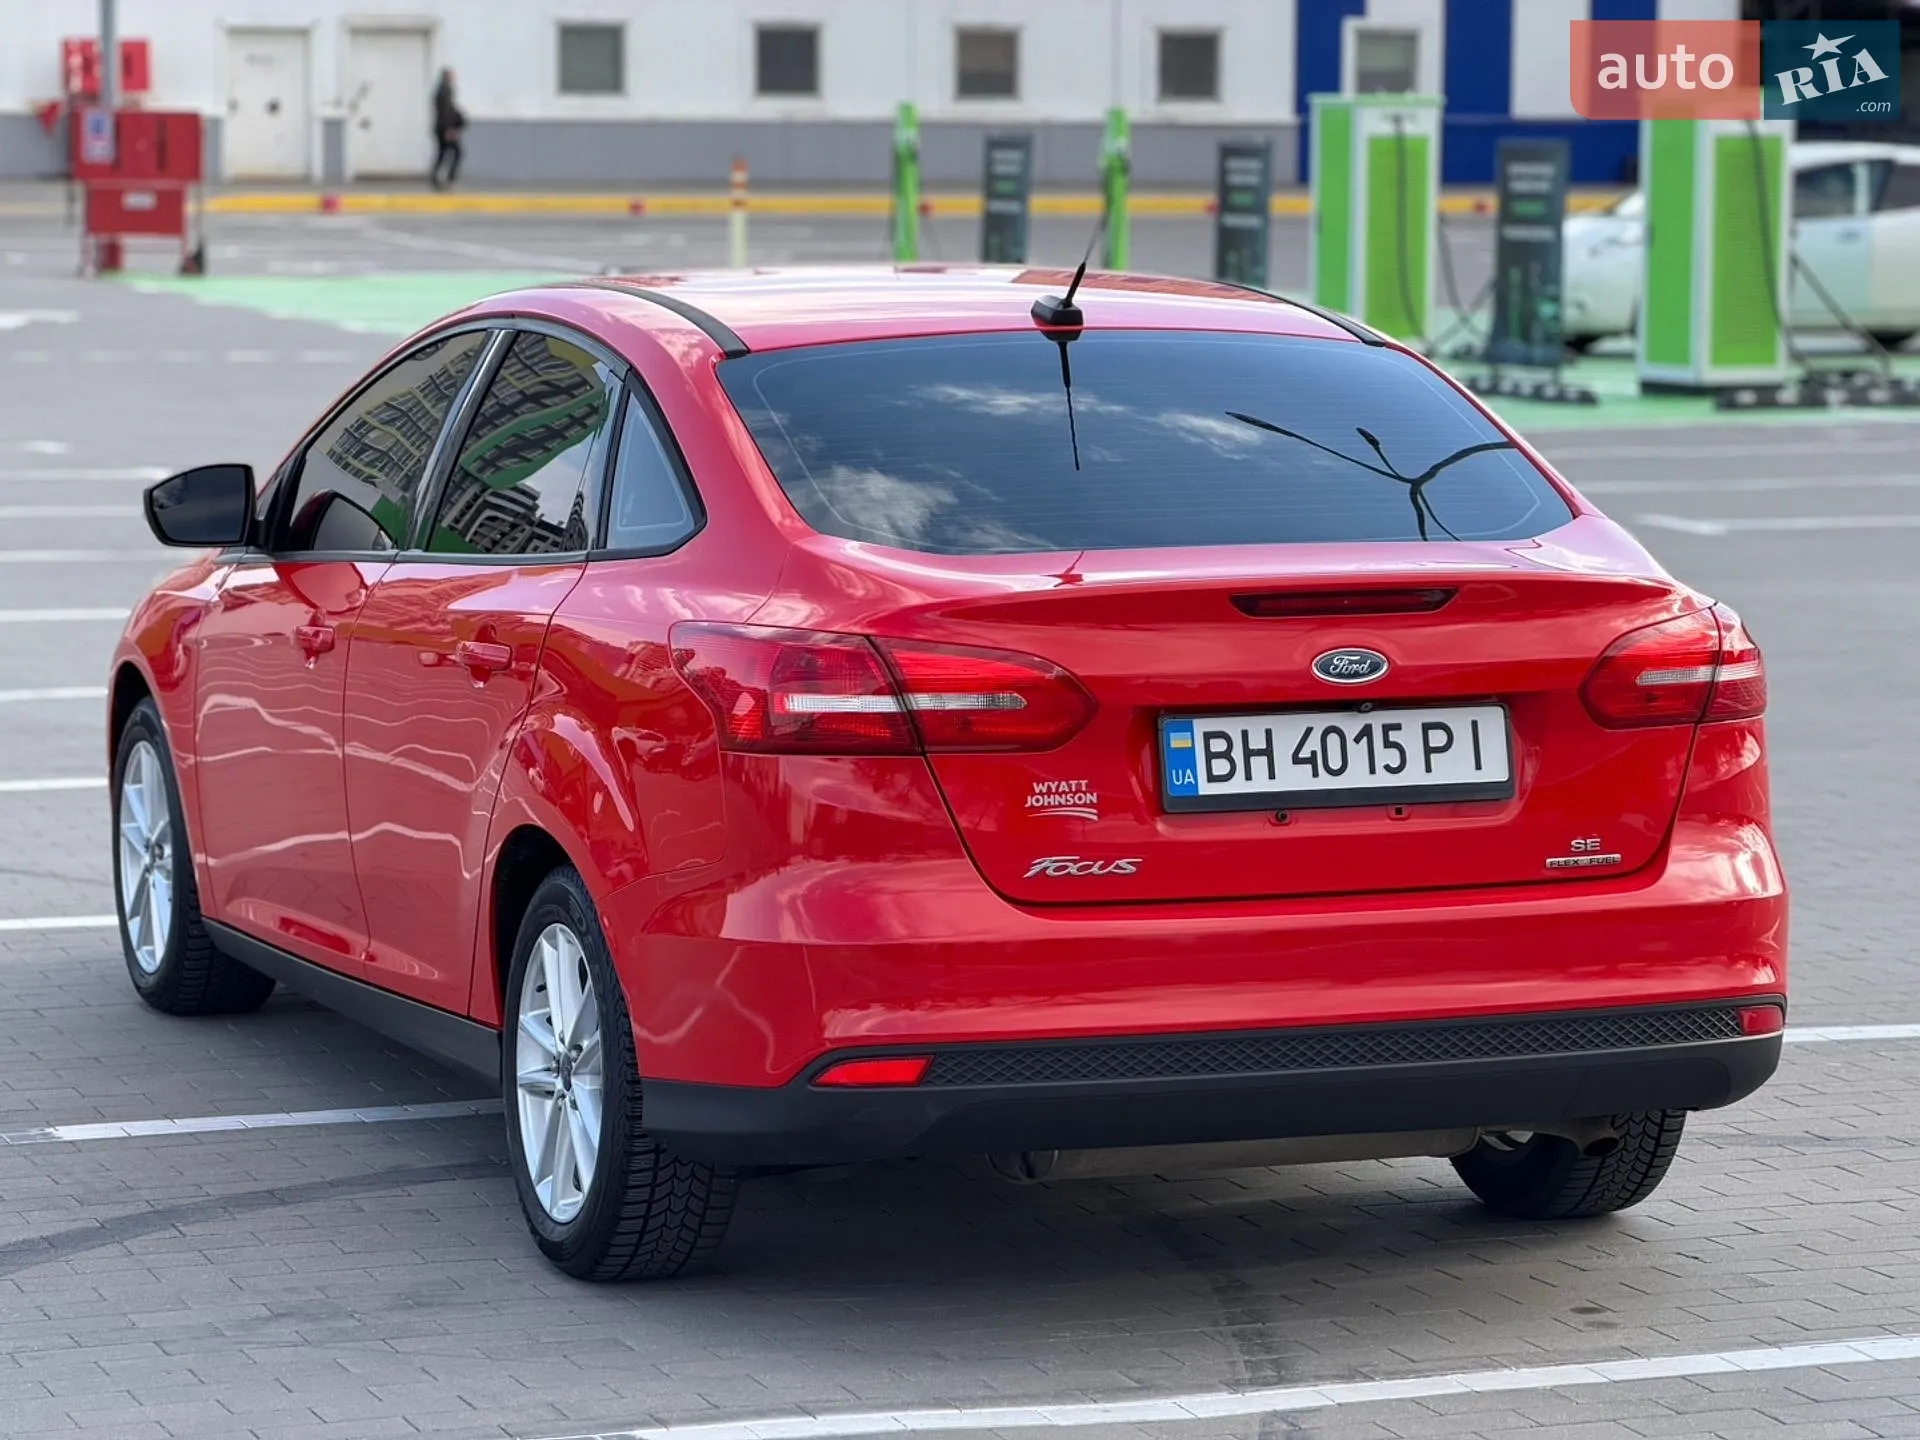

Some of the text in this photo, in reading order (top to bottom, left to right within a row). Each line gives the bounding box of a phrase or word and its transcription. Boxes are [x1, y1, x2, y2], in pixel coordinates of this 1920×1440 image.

[1329, 655, 1371, 674] Ford
[1202, 727, 1276, 784] BH
[1291, 722, 1408, 778] 4015
[1172, 769, 1195, 785] UA
[1033, 780, 1088, 793] WYATT
[1025, 792, 1097, 807] JOHNSON
[1570, 838, 1601, 852] SE
[1549, 856, 1619, 867] FLEX FUEL
